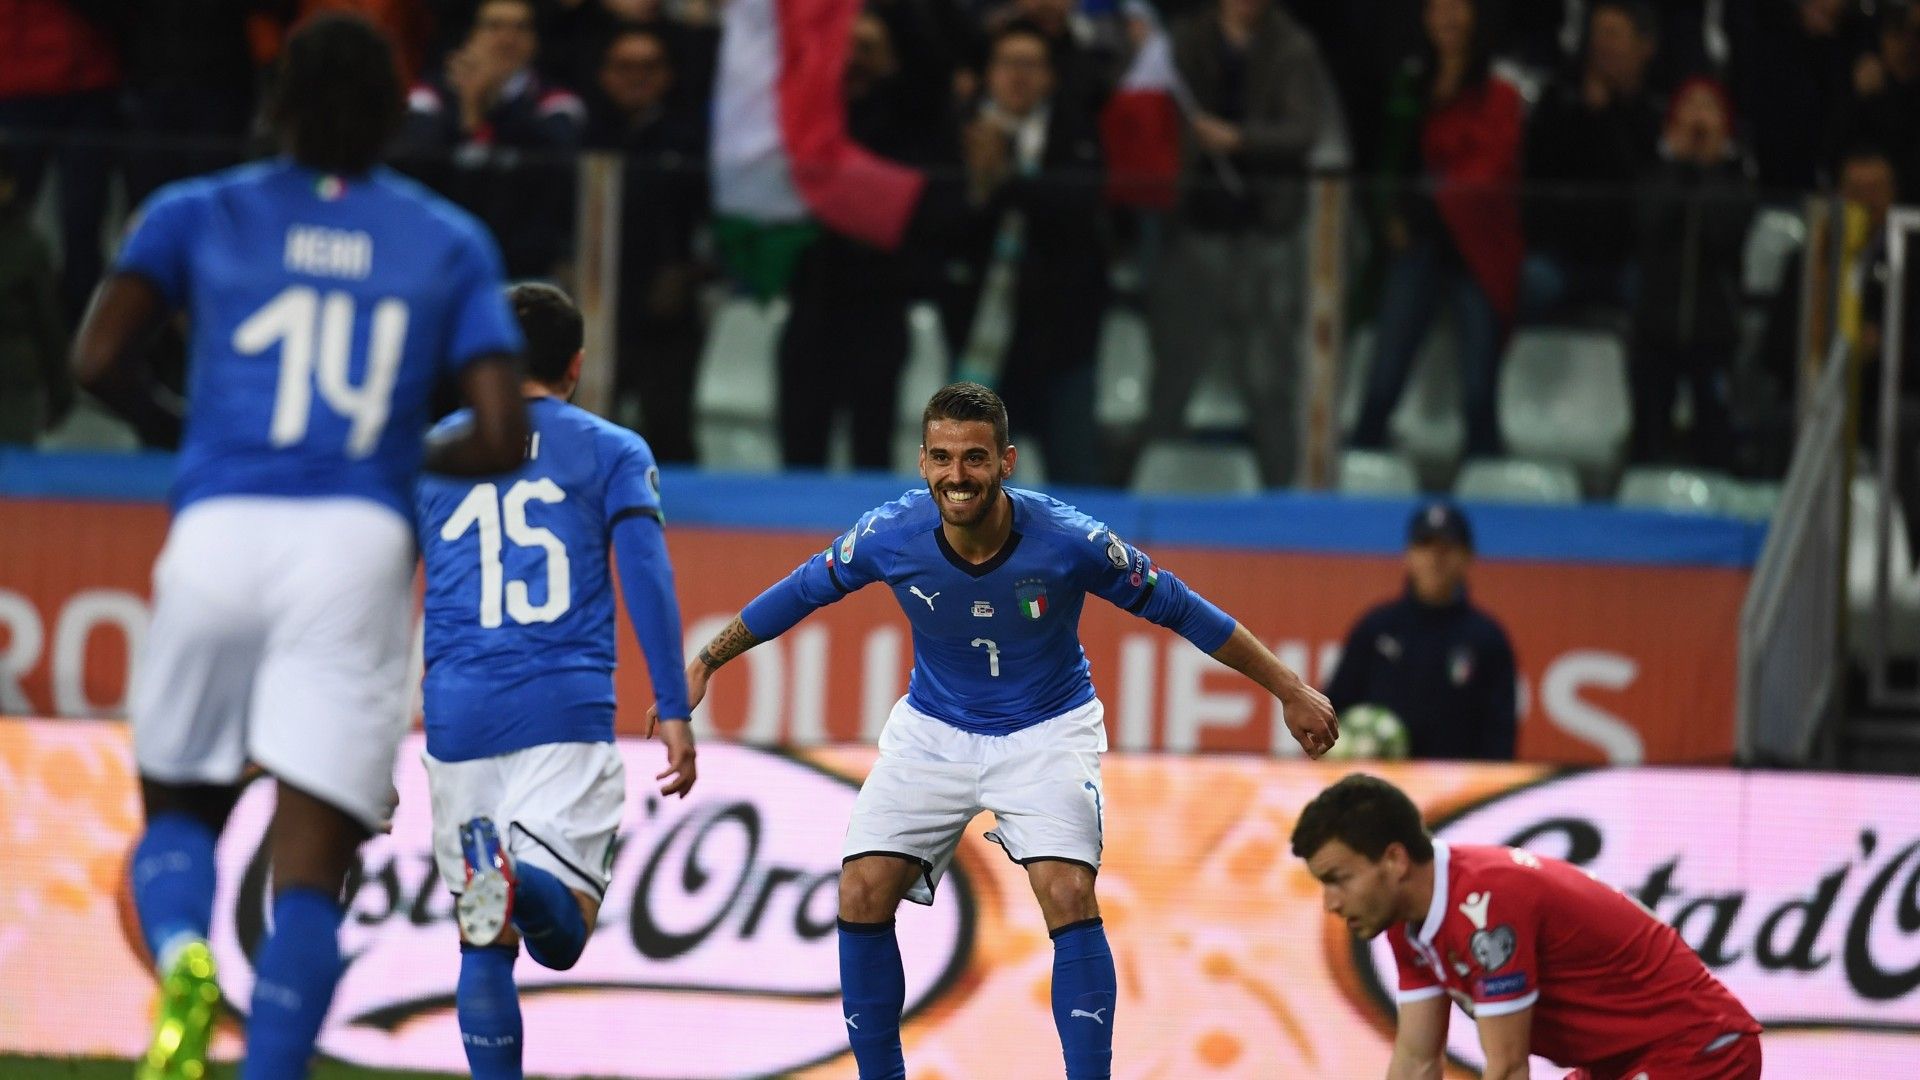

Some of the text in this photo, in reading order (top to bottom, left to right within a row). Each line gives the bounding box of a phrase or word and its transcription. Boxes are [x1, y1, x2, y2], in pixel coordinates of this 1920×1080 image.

[232, 285, 409, 460] 14
[440, 477, 571, 629] 15
[971, 638, 1000, 677] 7
